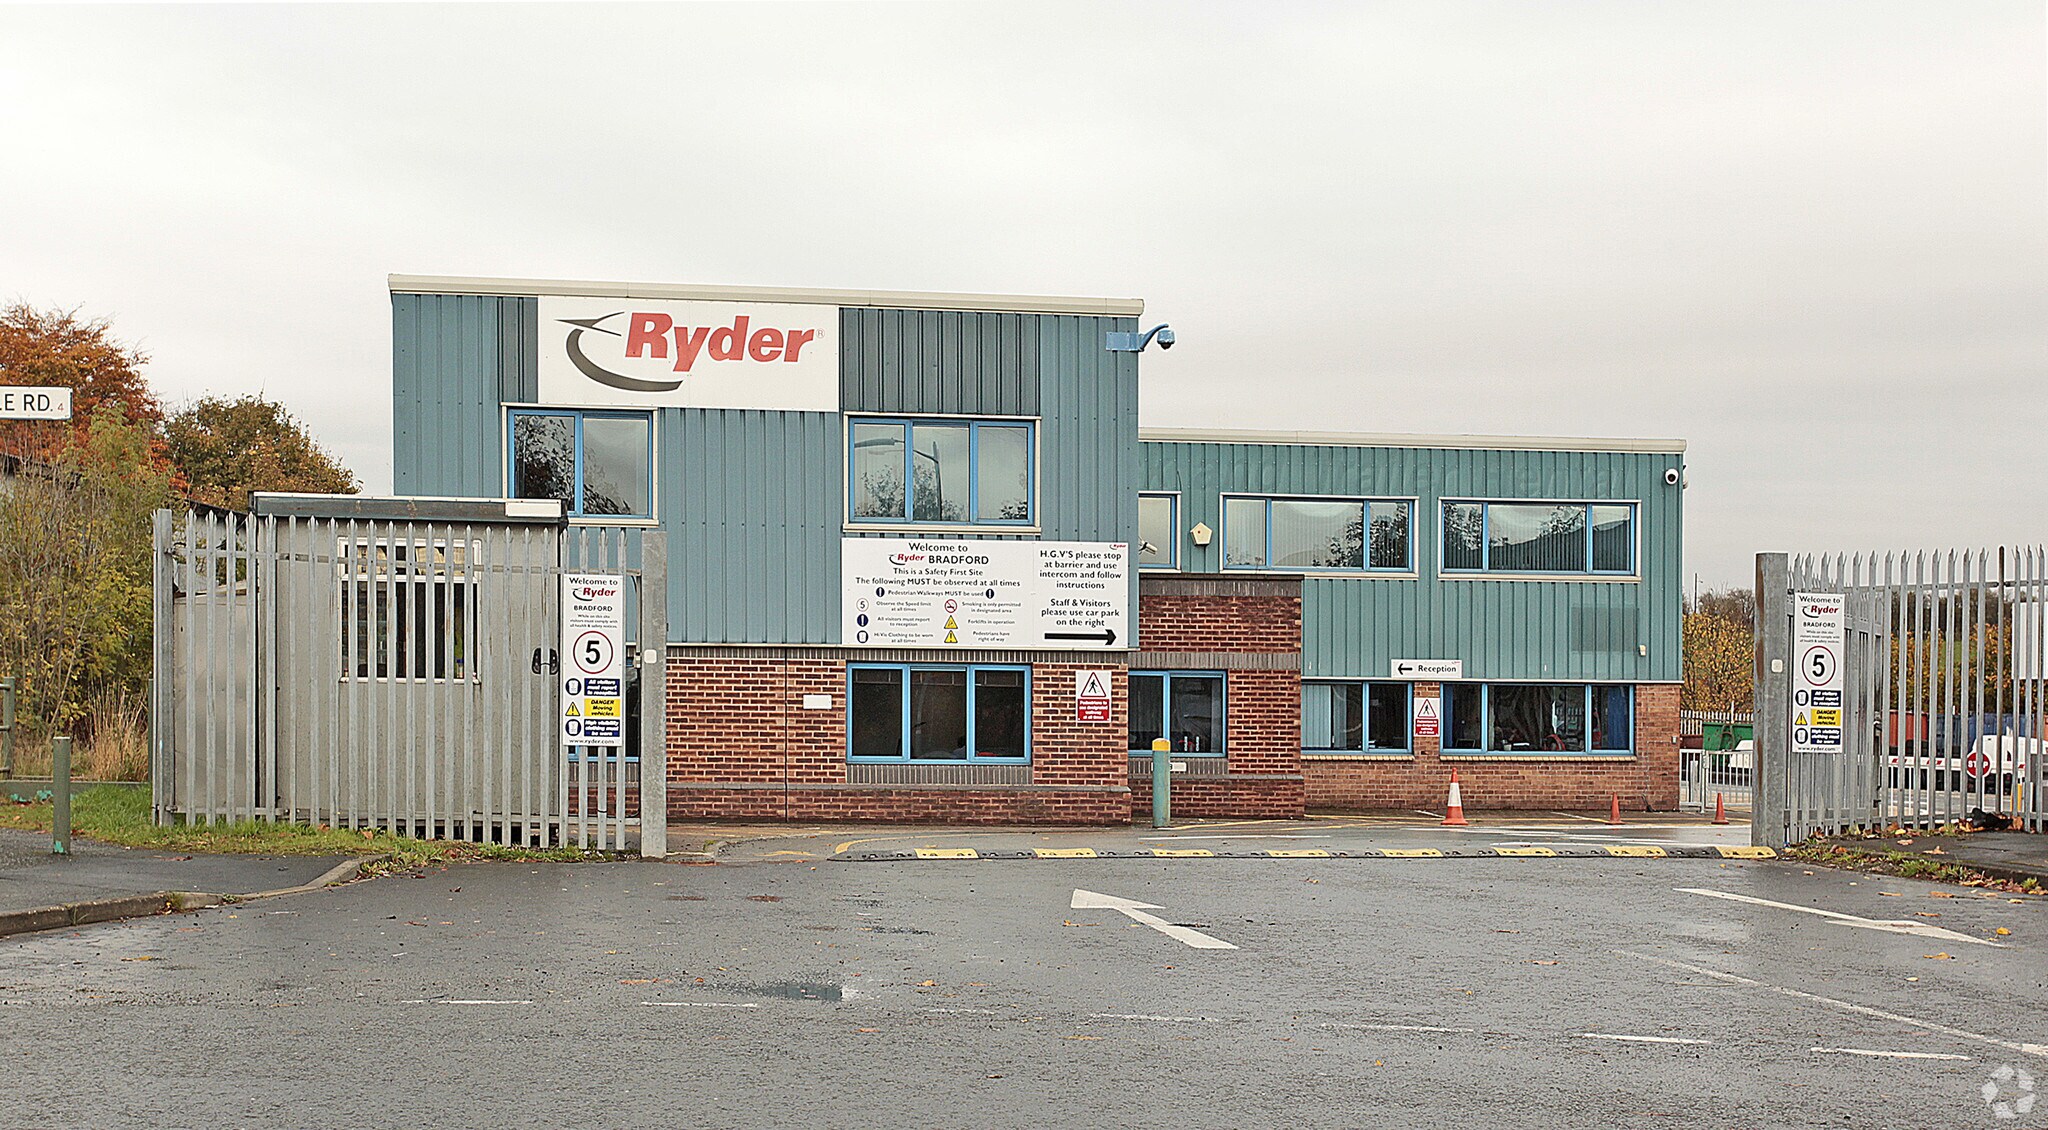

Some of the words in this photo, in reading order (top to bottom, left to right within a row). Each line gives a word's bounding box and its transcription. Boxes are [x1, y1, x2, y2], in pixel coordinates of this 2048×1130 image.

[625, 312, 815, 372] Ryder
[24, 394, 53, 411] RD.
[58, 403, 64, 412] 4
[909, 543, 955, 551] Welcome
[897, 554, 925, 562] Ryder
[928, 555, 989, 564] BRADFORD
[1040, 550, 1073, 558] H.G.V'S
[1076, 551, 1101, 560] please
[1103, 552, 1121, 560] stop
[1086, 561, 1101, 569] and
[924, 568, 948, 576] Safety
[1097, 571, 1121, 579] follow
[872, 578, 905, 586] following
[1057, 581, 1105, 589] instructions
[583, 588, 616, 597] Ryder
[1050, 598, 1070, 606] Staff
[1079, 599, 1111, 607] Visitors
[1799, 595, 1831, 603] Welcome
[860, 601, 865, 609] 5
[1811, 605, 1839, 614] Ryder
[1041, 608, 1067, 617] please
[1101, 609, 1120, 618] park
[1085, 618, 1105, 628] right
[585, 640, 600, 664] 5
[1418, 665, 1456, 674] Reception
[1812, 655, 1825, 677] 5
[1968, 760, 1988, 768] STP
